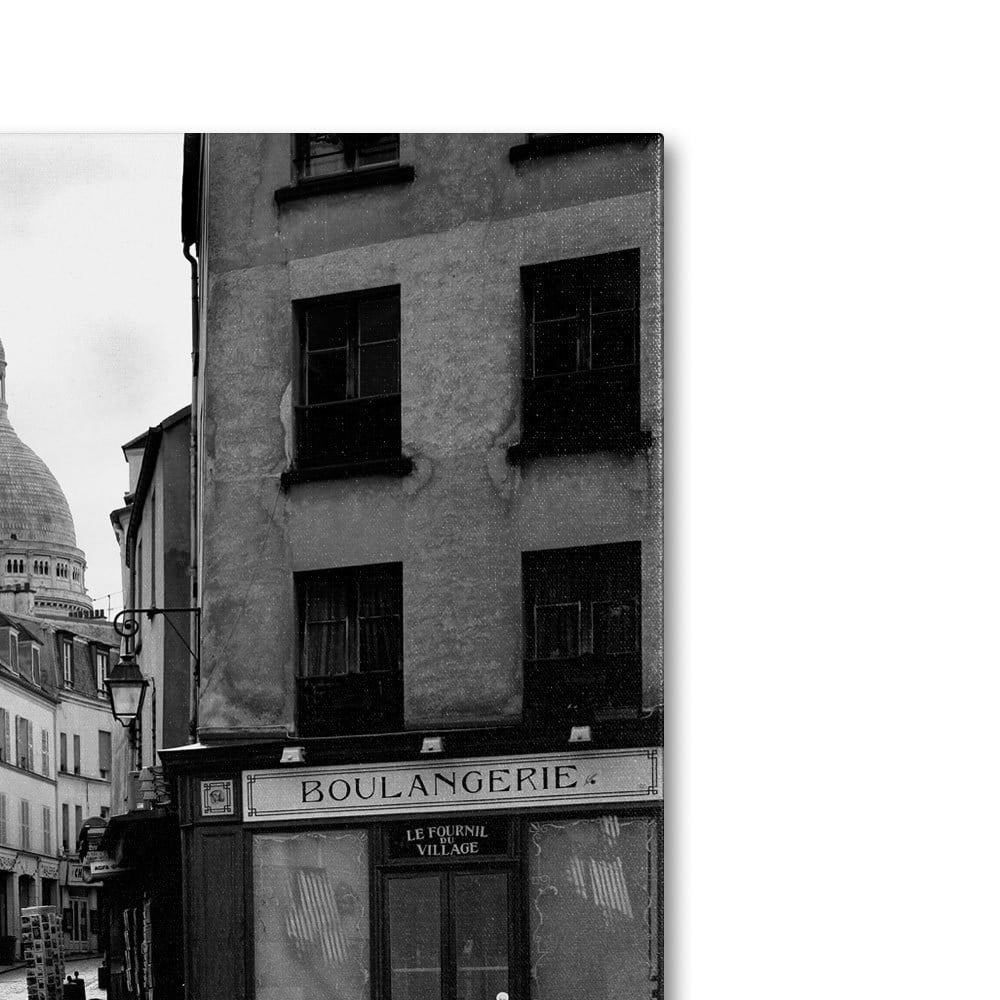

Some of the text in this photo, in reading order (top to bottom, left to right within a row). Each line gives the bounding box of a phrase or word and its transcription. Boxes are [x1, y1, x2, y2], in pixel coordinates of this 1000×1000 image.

[301, 765, 578, 803] BOULANGERIE
[406, 825, 488, 841] LE FOURNIL
[417, 842, 479, 856] VILLAGE
